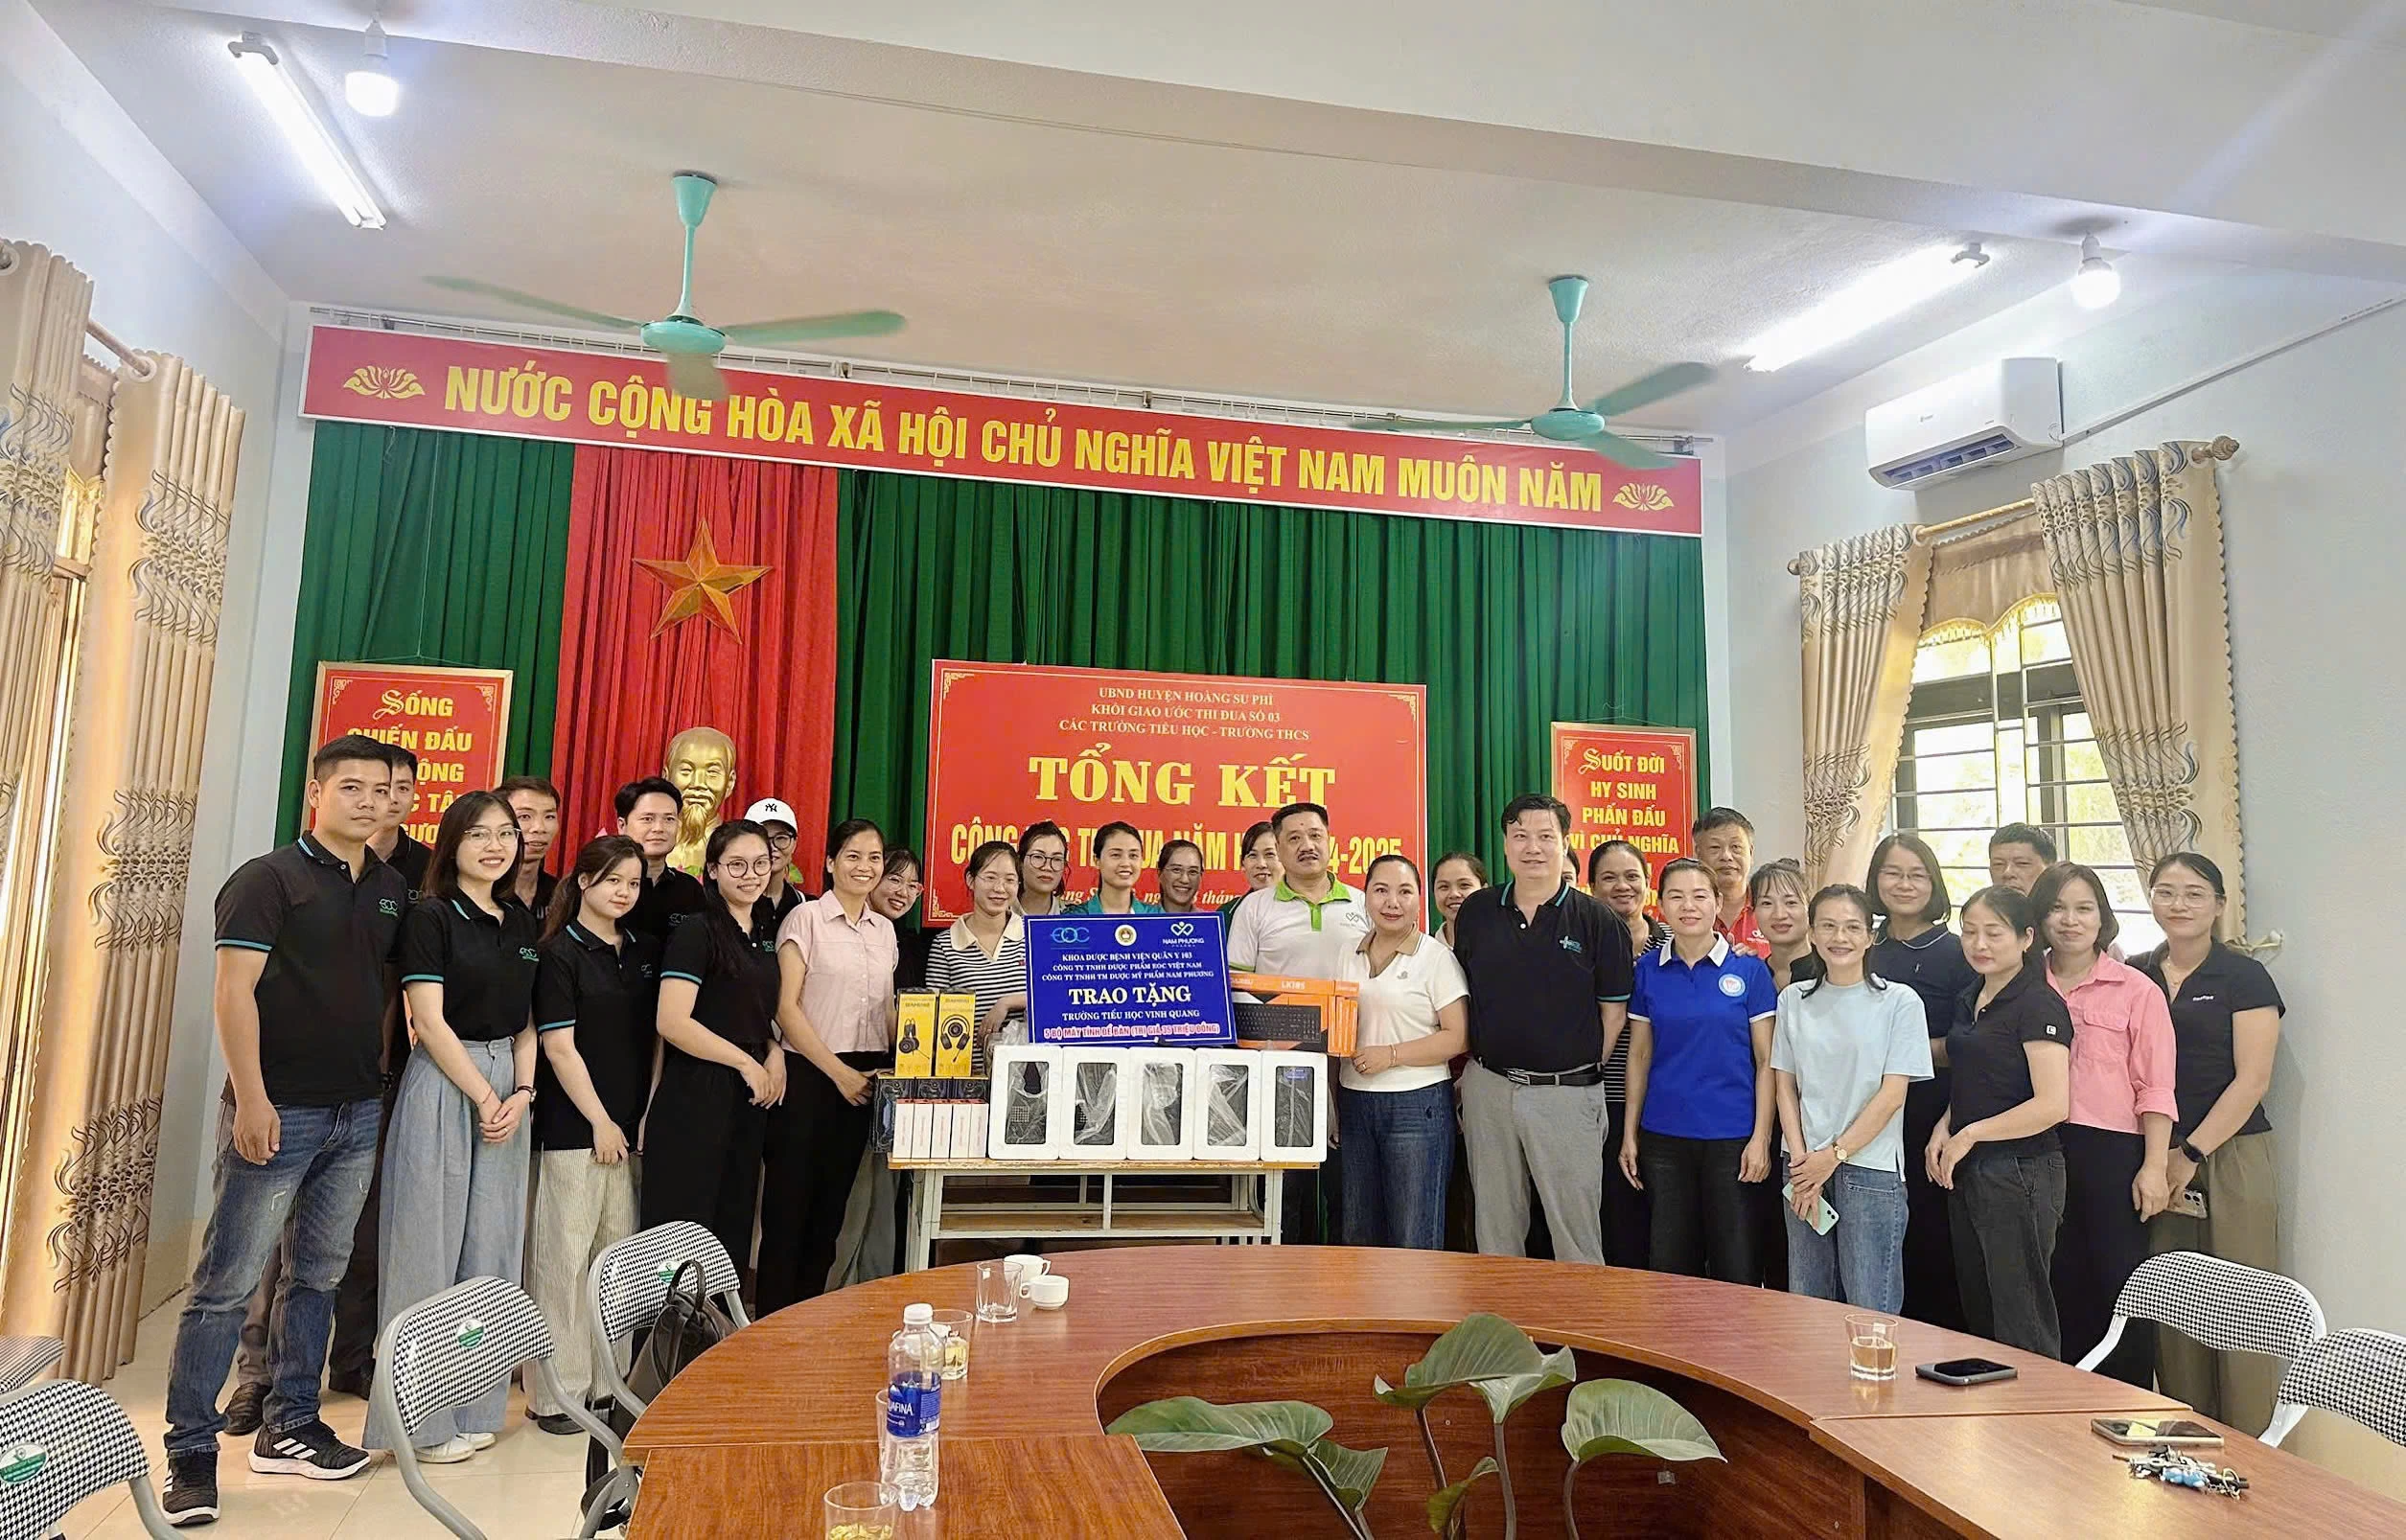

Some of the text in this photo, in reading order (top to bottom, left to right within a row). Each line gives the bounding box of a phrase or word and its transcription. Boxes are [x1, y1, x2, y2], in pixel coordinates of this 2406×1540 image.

[444, 359, 1602, 513] NƯỚC CỘNG HÒA XÃ HỘI CHỦ NGHĨA VIỆT NAM MUÔN NĂM
[373, 689, 454, 721] SỐNG
[1099, 687, 1274, 706] UBND HUYỆN HOÀNG SU PHÌ
[1128, 704, 1162, 718] GIAO
[1165, 704, 1193, 720] ƯỚC
[1195, 708, 1218, 721] THI
[1220, 709, 1247, 722] ĐUA
[1267, 711, 1281, 724] 03
[424, 725, 473, 752] ĐẤU
[1058, 717, 1087, 731] CÁC
[1090, 719, 1146, 734] TRƯỜNG
[1182, 724, 1209, 739] HỌC
[1219, 724, 1274, 740] TRƯỜNG
[1276, 728, 1309, 742] THCS
[416, 759, 465, 786] ỘNG
[1578, 748, 1665, 775] SUỐT ĐỜI
[1029, 743, 1336, 811] TỔNG KẾT
[1590, 781, 1657, 800] HY SINH
[1582, 802, 1666, 827] PHẤN ĐẤU
[1629, 833, 1680, 854] NGHĨA
[1062, 954, 1085, 962] KHOA
[1042, 973, 1064, 981] CÔNG
[1069, 982, 1191, 1007] TRAO TẶNG
[1062, 1010, 1100, 1021] TRƯỜNG
[1124, 1010, 1144, 1021] HỌC
[1145, 1010, 1167, 1019] VINH
[1168, 1009, 1200, 1019] QUANG
